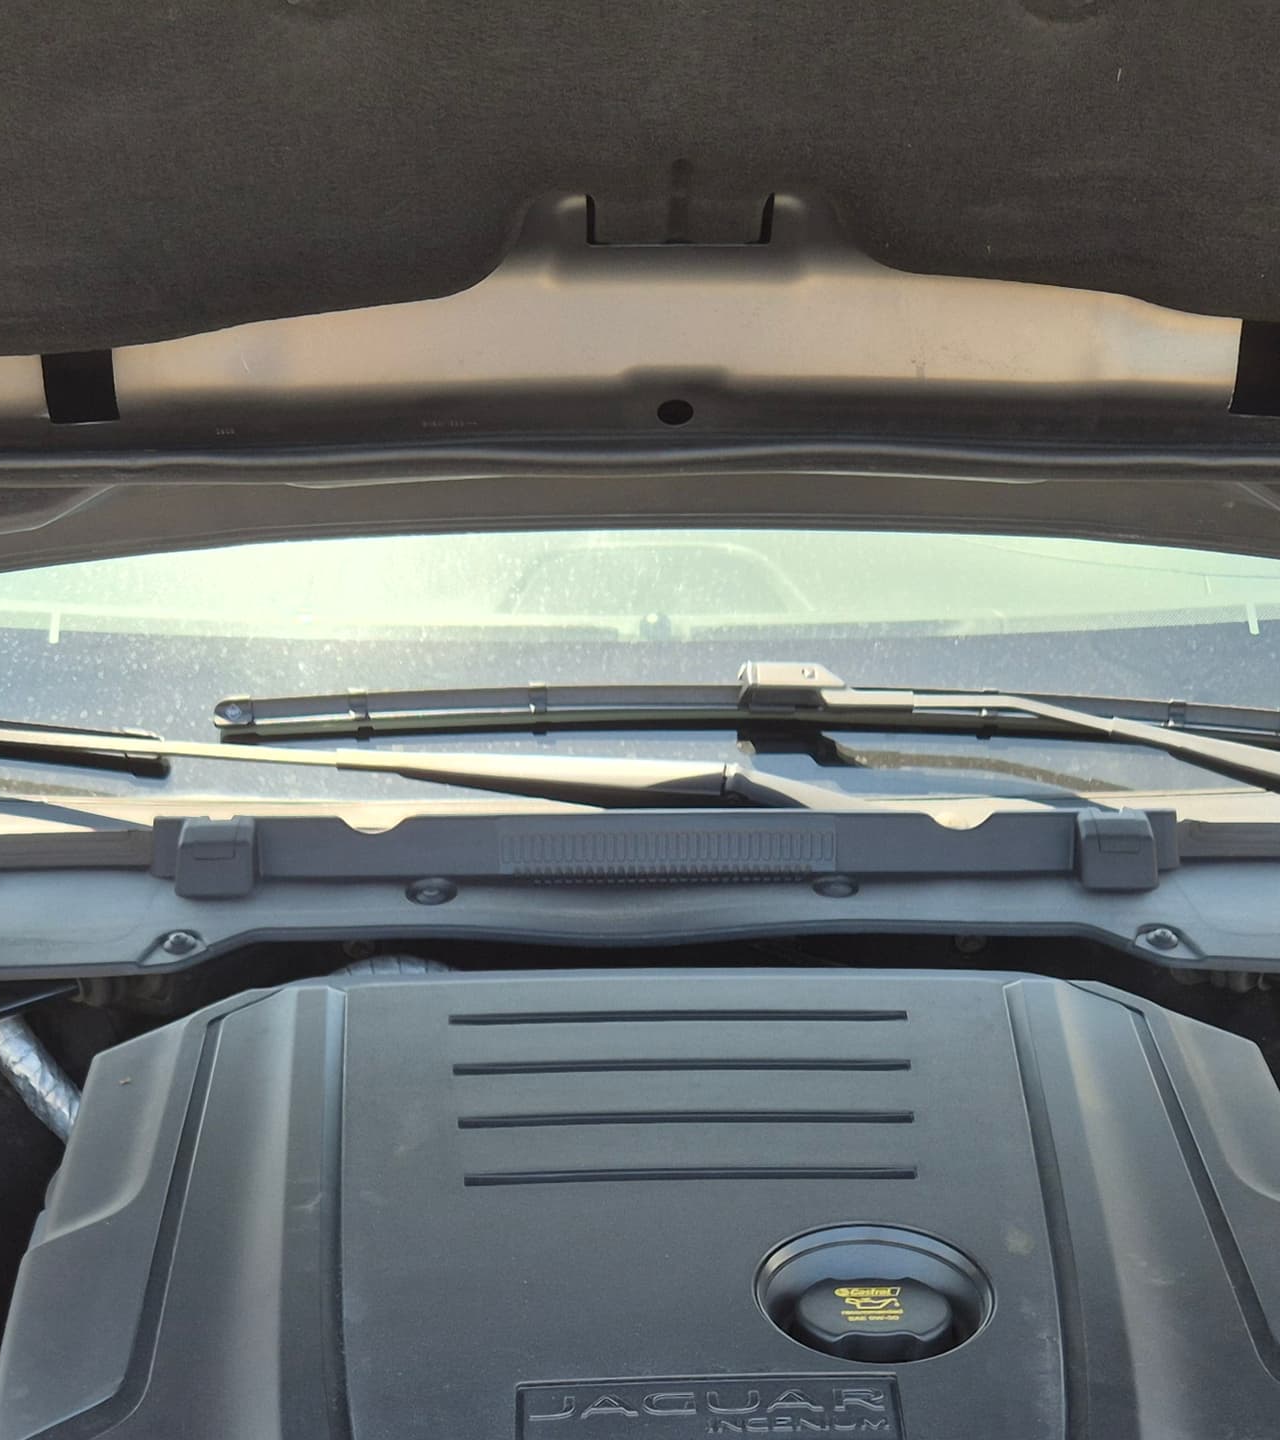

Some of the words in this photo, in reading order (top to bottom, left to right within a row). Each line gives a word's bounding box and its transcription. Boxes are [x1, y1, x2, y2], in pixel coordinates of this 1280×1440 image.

[850, 1287, 889, 1297] Castrol
[528, 1388, 886, 1421] JAGUAR
[705, 1416, 891, 1434] INGENIUM
